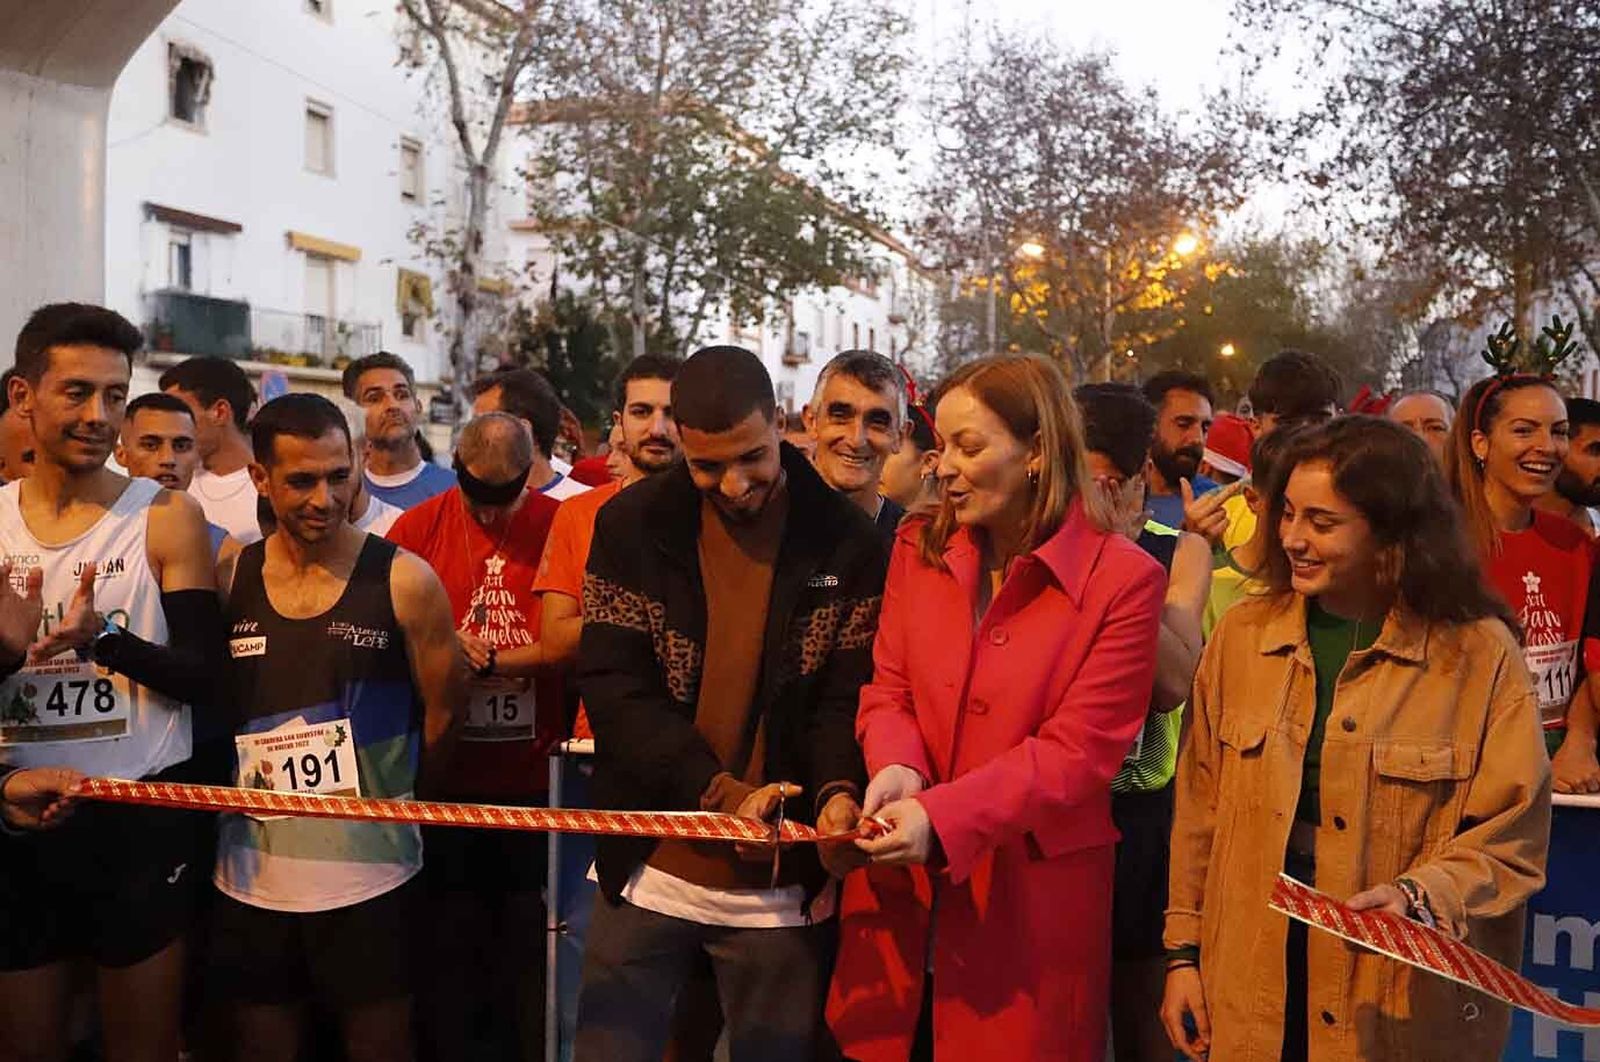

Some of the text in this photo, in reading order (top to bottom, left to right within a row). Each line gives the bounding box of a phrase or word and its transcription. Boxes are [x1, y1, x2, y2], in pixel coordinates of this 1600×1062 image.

[46, 678, 115, 716] 478
[1545, 664, 1572, 699] 111
[486, 694, 518, 721] 15
[282, 749, 341, 790] 191
